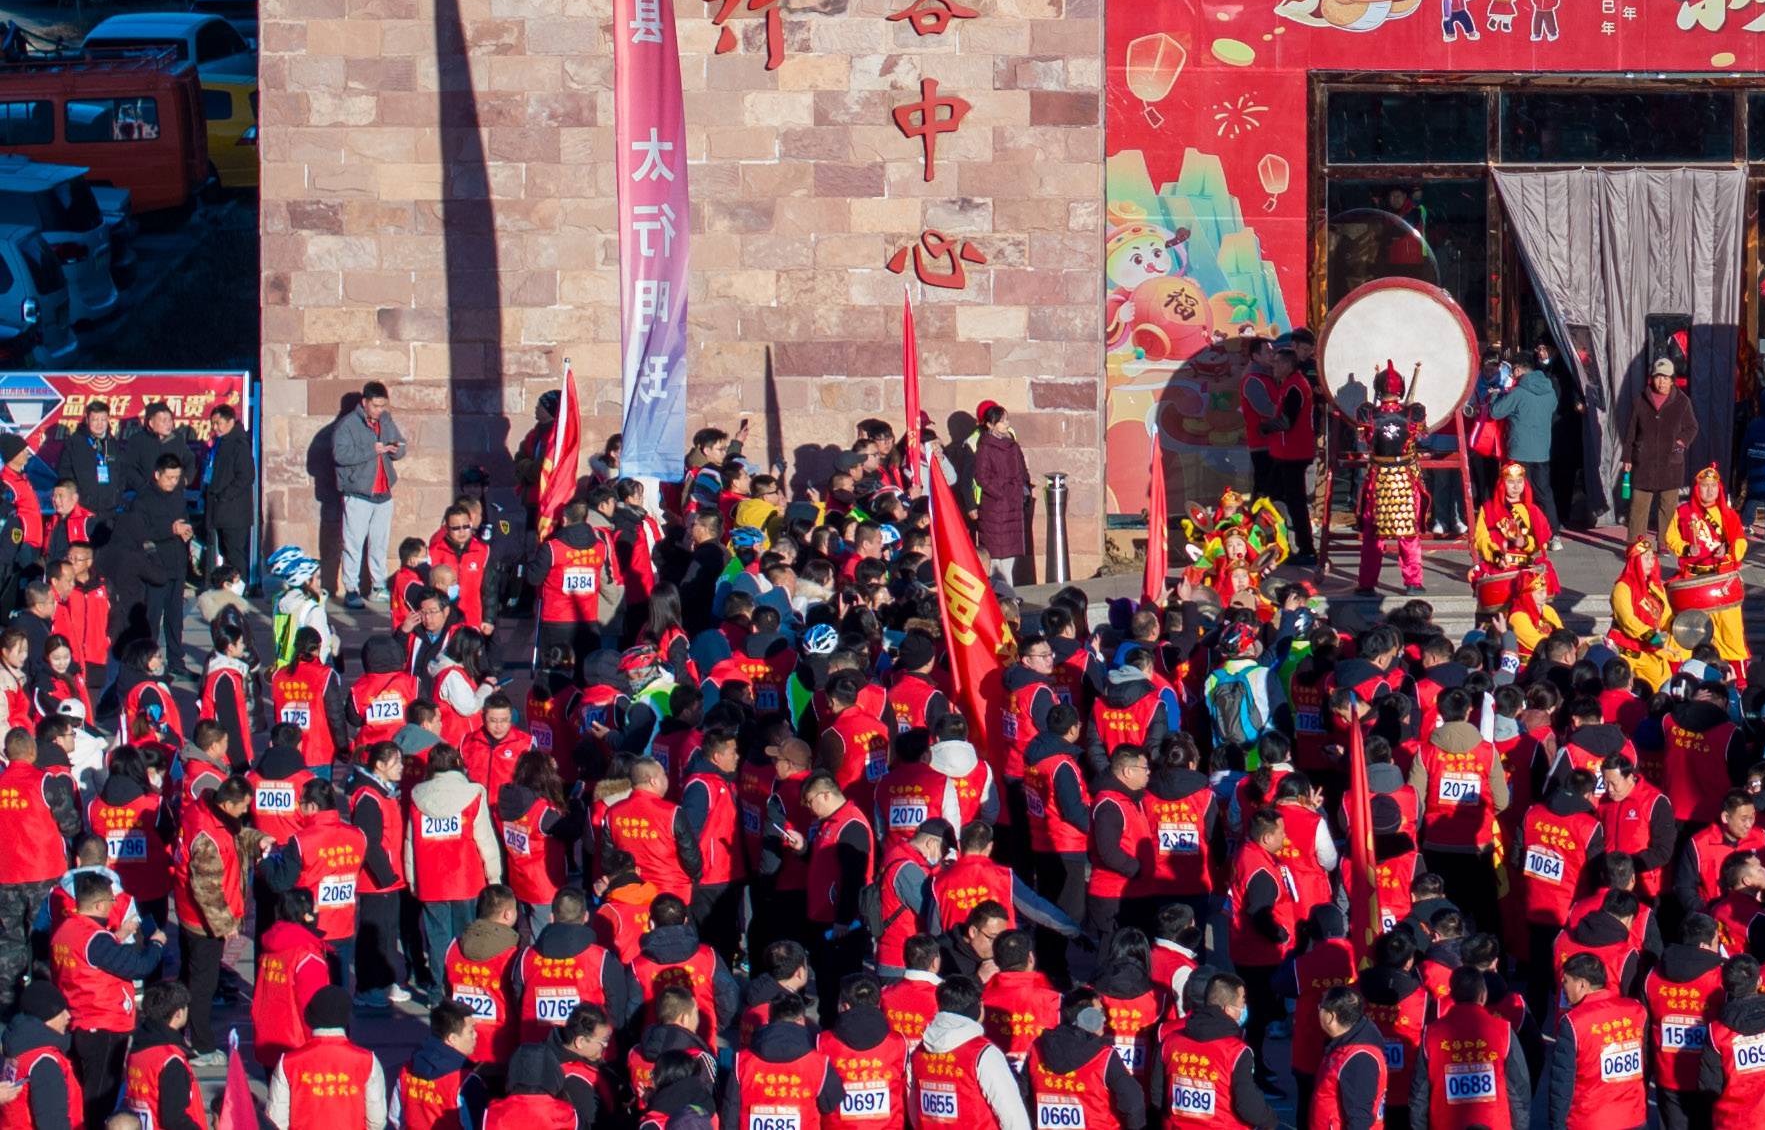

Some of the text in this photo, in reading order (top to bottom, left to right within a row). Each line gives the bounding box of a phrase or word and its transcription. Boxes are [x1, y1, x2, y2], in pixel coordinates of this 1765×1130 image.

[1165, 288, 1199, 321] 福
[567, 576, 592, 590] 1384
[367, 702, 399, 719] 1723
[260, 791, 291, 808] 2060
[1444, 781, 1475, 799] 2071
[425, 816, 458, 834] 2036
[892, 807, 923, 824] 2070
[109, 839, 145, 856] 1796
[1529, 853, 1561, 877] 1064
[322, 884, 354, 902] 2063
[1666, 1026, 1706, 1046] 1558
[1604, 1051, 1640, 1075] 0686
[1448, 1074, 1492, 1096] 0688
[843, 1092, 885, 1112] 0697
[922, 1093, 954, 1114] 0655
[1174, 1087, 1212, 1111] 0689
[1041, 1106, 1081, 1125] 0660
